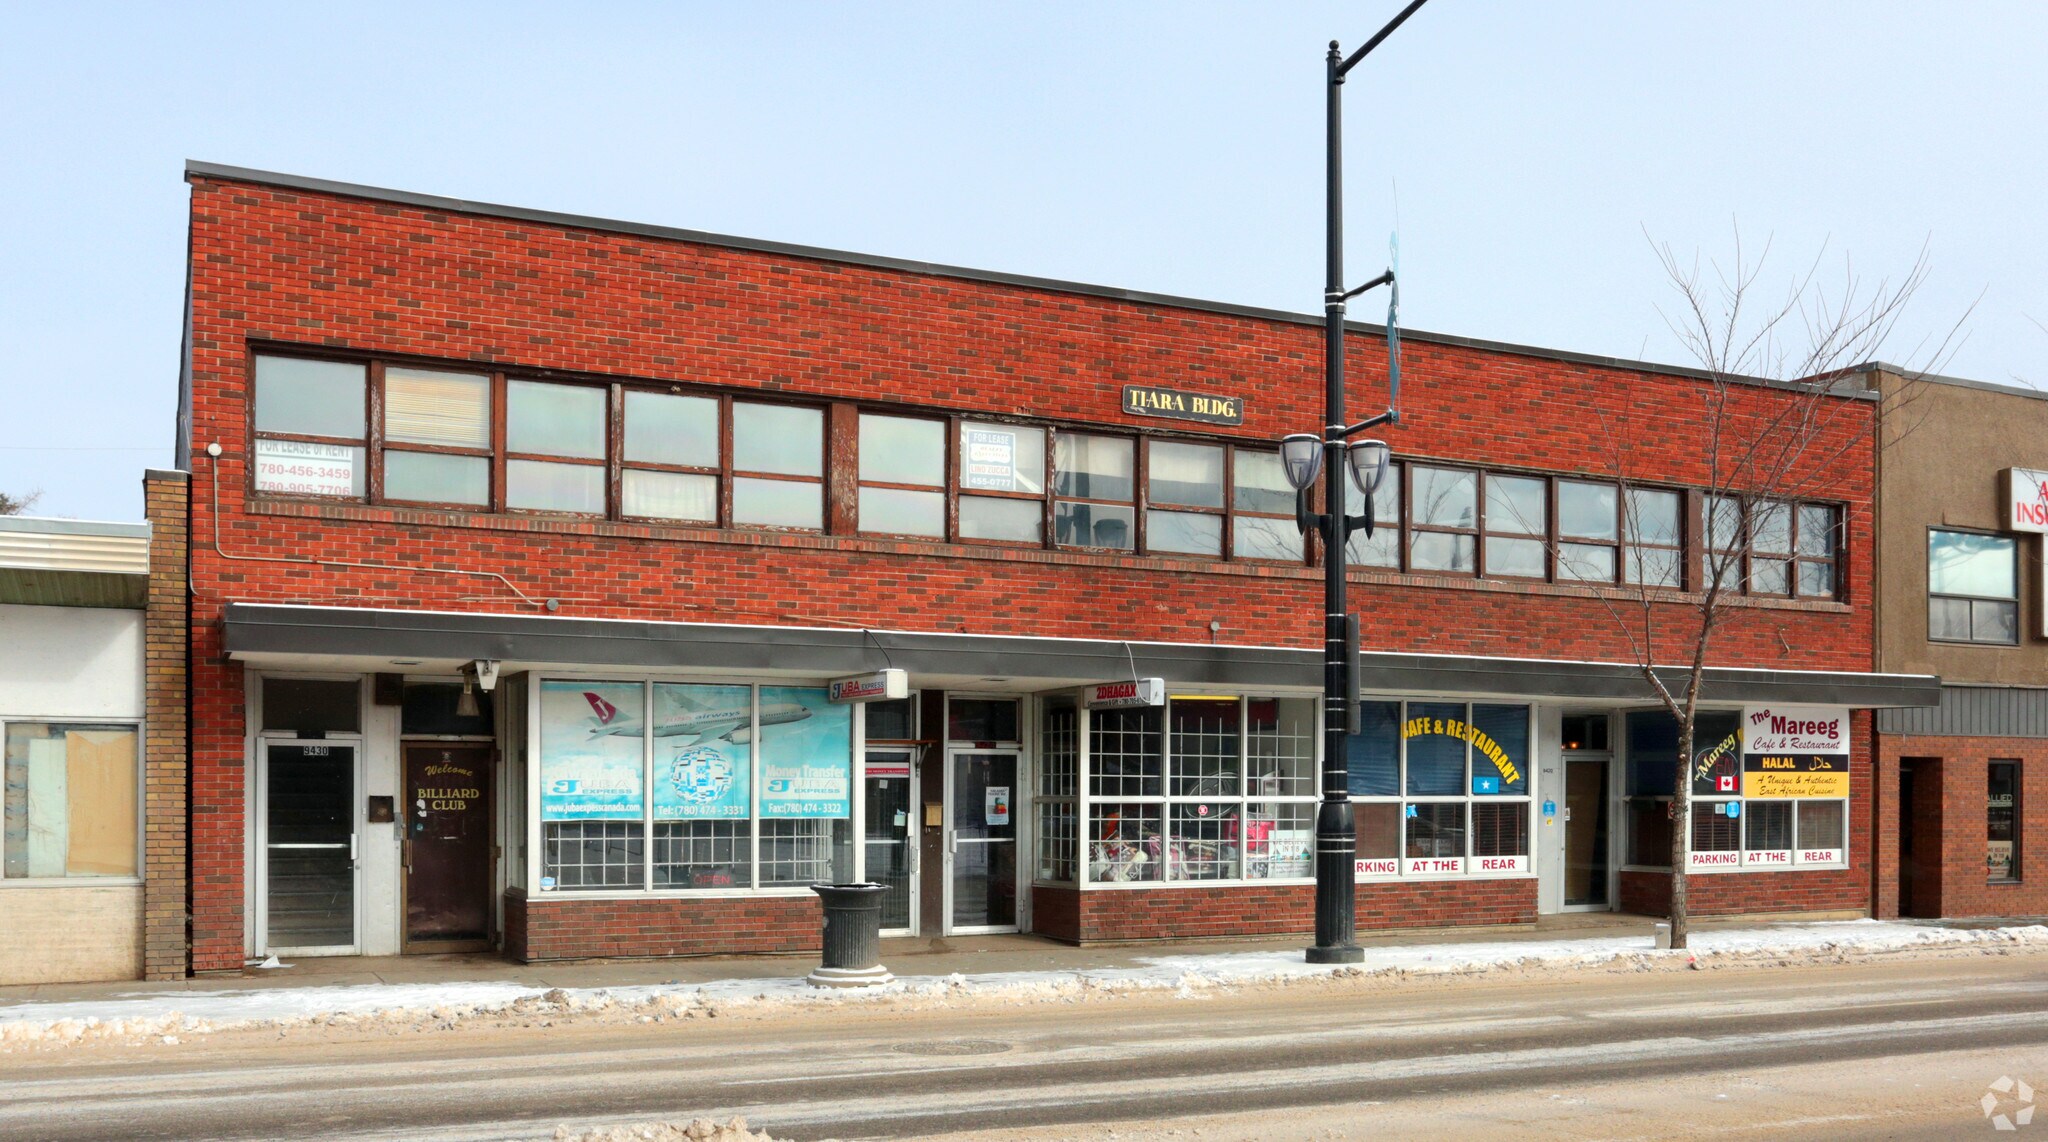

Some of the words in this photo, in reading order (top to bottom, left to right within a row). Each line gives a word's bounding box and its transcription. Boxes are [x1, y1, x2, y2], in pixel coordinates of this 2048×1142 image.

[1129, 389, 1186, 412] TIARA
[1191, 396, 1237, 417] BLDG.
[973, 432, 987, 442] FOR
[988, 434, 1009, 445] LEASE
[260, 441, 279, 453] FOR
[281, 442, 311, 455] LEASE
[325, 447, 350, 458] RENT
[260, 463, 351, 480] 780-456-3459
[832, 681, 860, 699] JUBA
[861, 681, 885, 691] EXPRESS
[1096, 683, 1137, 700] 2DHAGAX
[695, 711, 740, 720] airways
[1750, 708, 1771, 726] The
[1771, 715, 1839, 740] Mareeg
[304, 746, 328, 755] 9430
[1753, 736, 1776, 752] Cafe
[1779, 737, 1786, 749] &
[1790, 737, 1840, 750] Restaurant
[1433, 719, 1444, 734] &
[1446, 718, 1520, 785] RESTAURANT
[1698, 733, 1736, 777] Mareeg
[424, 763, 473, 777] Welcome
[1762, 757, 1796, 769] HALAL
[1808, 756, 1832, 771] حلال
[766, 764, 800, 778] Money
[802, 764, 845, 778] Transfer
[1756, 775, 1764, 784] A
[1767, 775, 1793, 787] Unique
[1803, 775, 1837, 784] Authentic
[417, 788, 480, 799] BILLIARD
[1759, 785, 1777, 796] East
[1779, 786, 1806, 797] African
[1808, 785, 1835, 796] Cuisine
[431, 800, 467, 810] CLUB
[657, 805, 674, 815] Tel:
[674, 805, 698, 816] (780)
[700, 806, 717, 815] 474
[723, 805, 744, 815] 3331
[803, 803, 818, 813] 474
[822, 803, 842, 813] 3322
[1692, 853, 1737, 864] PARKING
[1748, 853, 1762, 862] AT
[1765, 852, 1786, 861] THE
[1804, 851, 1832, 861] REAR
[1355, 861, 1396, 873] RKING
[1412, 861, 1428, 871] AT
[1433, 860, 1458, 871] THE
[1482, 859, 1516, 870] REAR
[693, 874, 731, 885] OPEN
